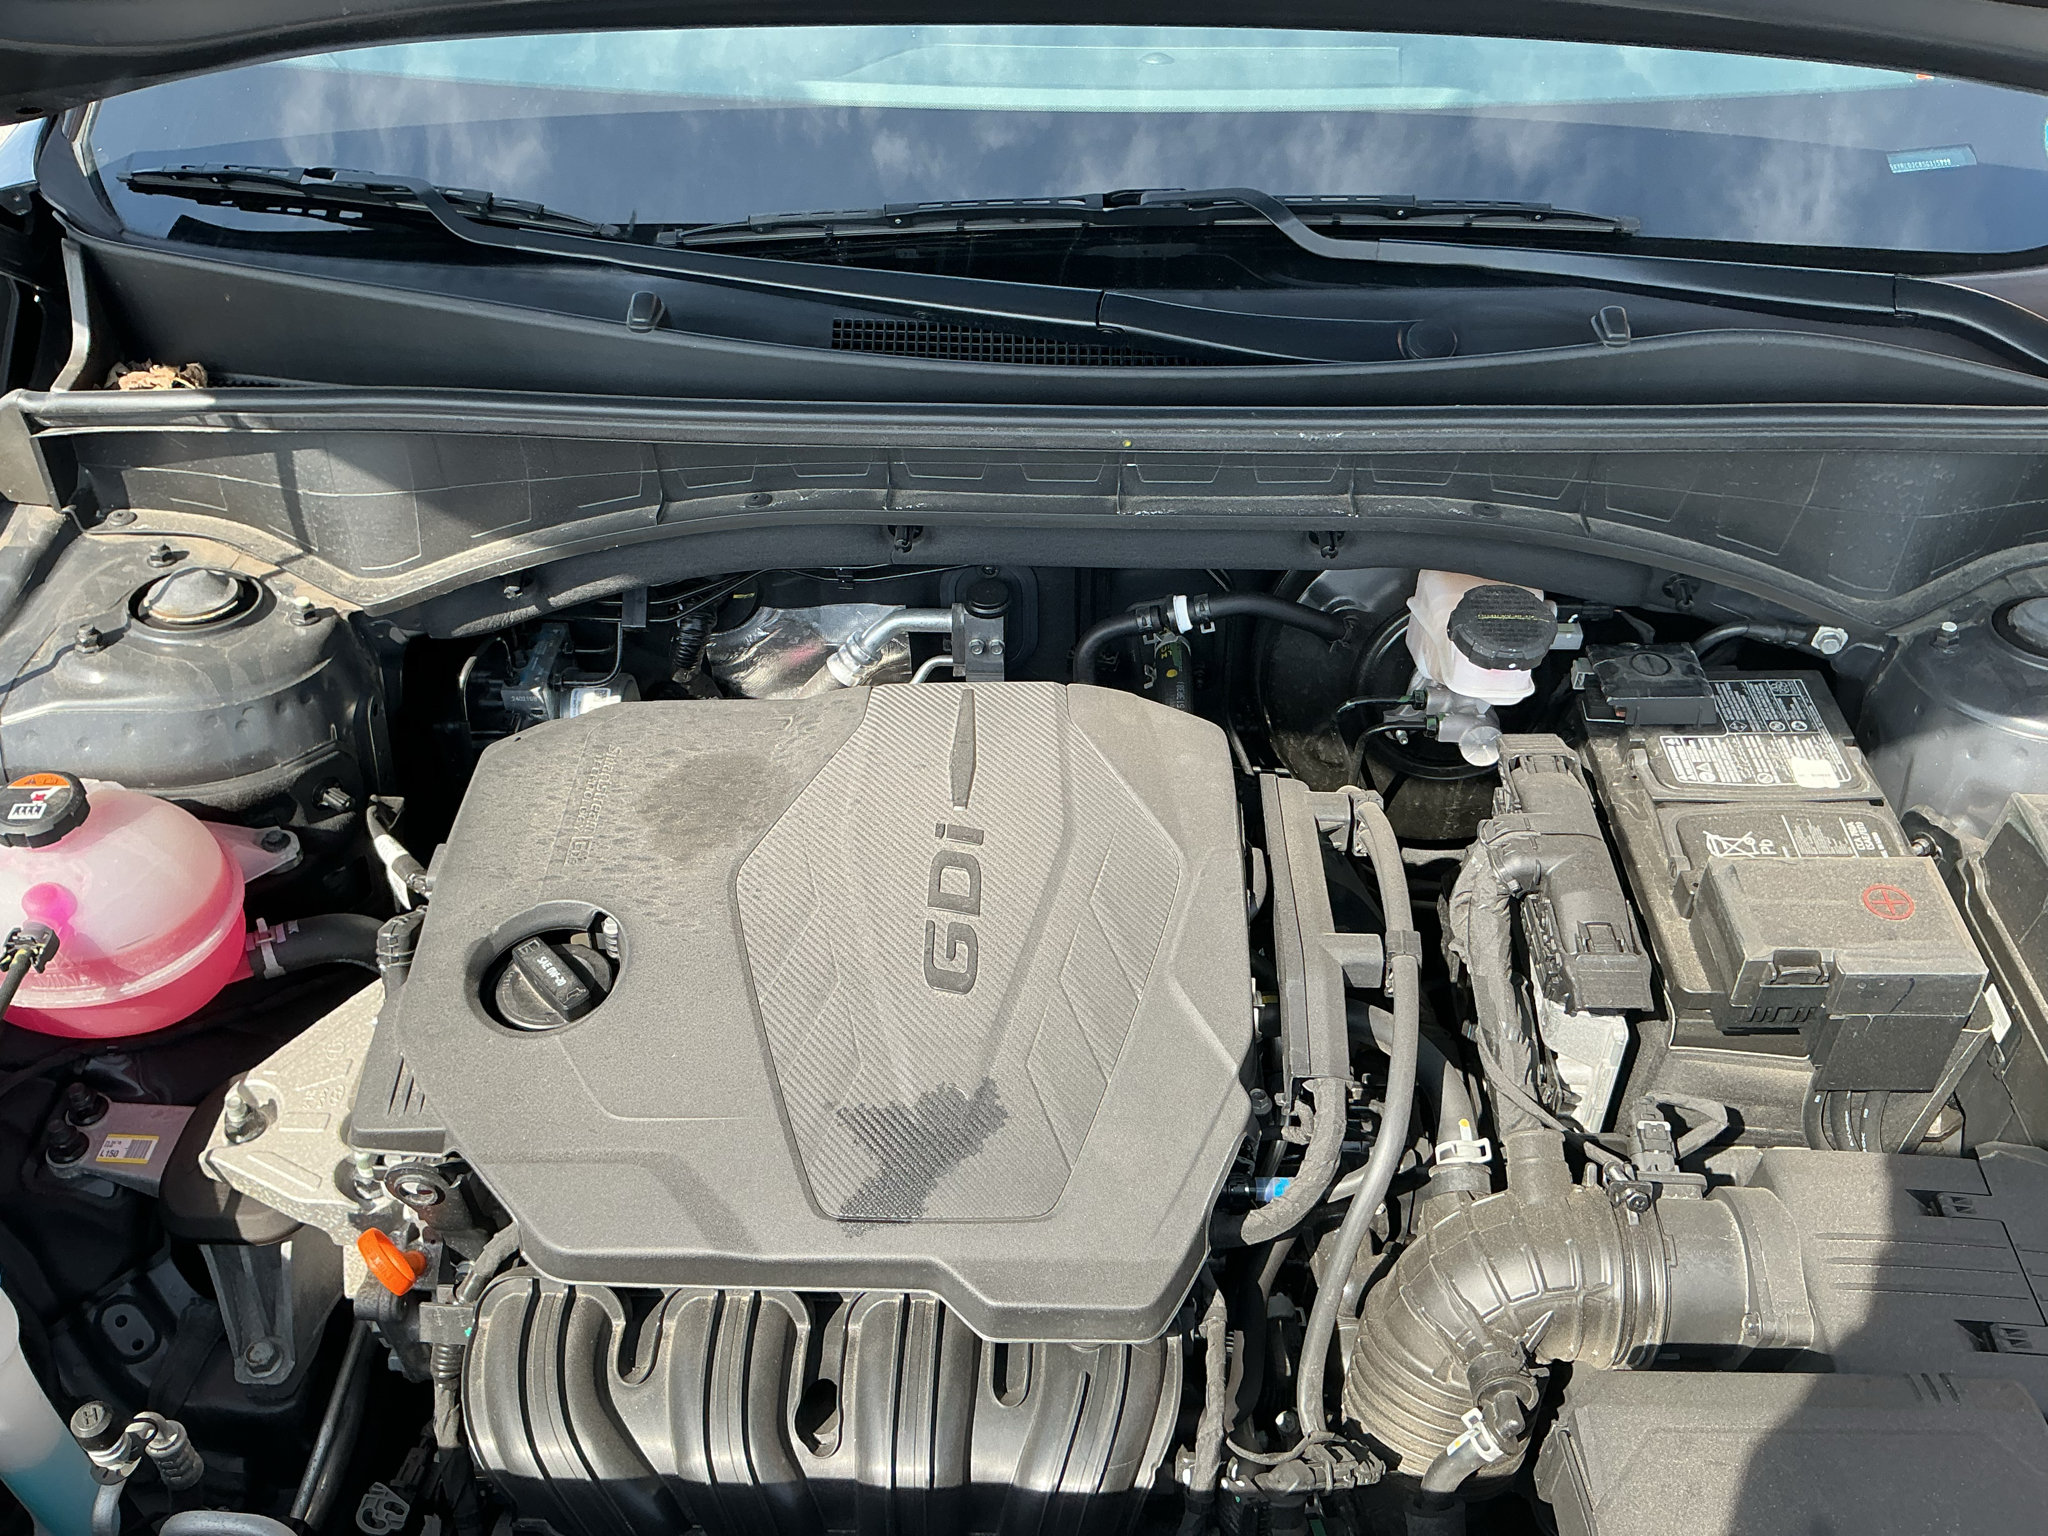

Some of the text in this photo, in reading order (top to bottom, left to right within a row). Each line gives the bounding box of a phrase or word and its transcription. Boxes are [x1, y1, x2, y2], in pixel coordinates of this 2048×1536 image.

[1759, 838, 1778, 855] Pb
[1853, 837, 1866, 851] CCA
[537, 956, 567, 987] SAE 0W-20
